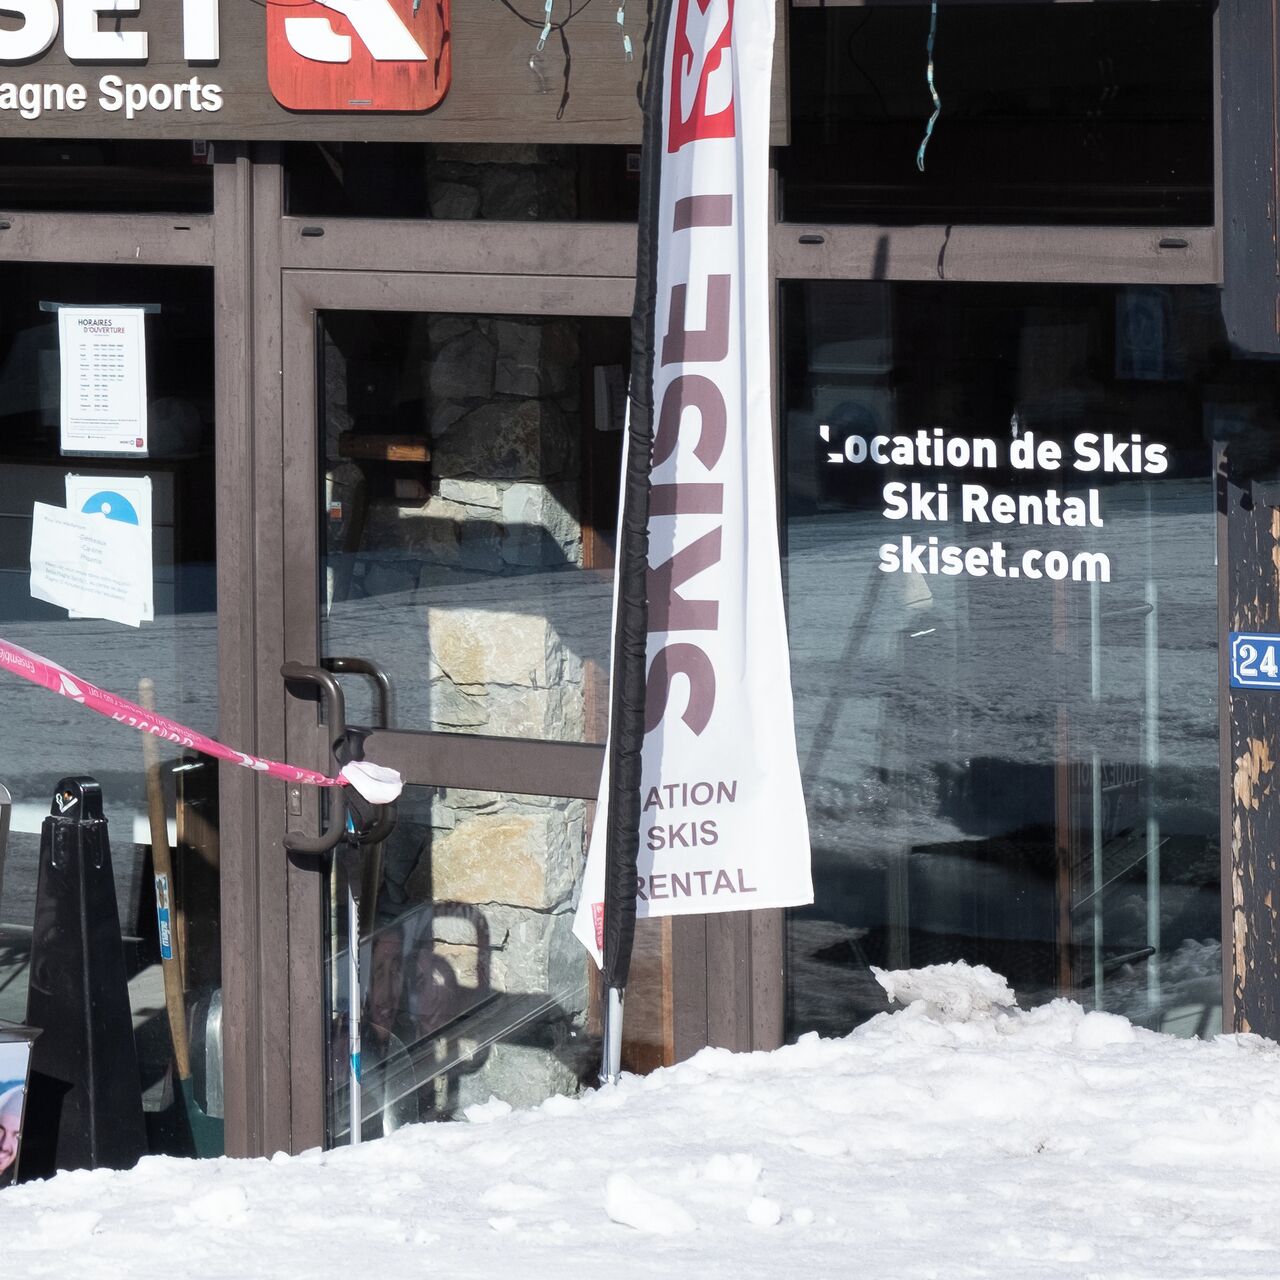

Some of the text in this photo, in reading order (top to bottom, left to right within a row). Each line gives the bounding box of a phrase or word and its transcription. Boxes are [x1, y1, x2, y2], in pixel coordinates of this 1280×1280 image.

[98, 75, 224, 118] Sports
[78, 319, 112, 327] HORAIRES
[1010, 431, 1061, 471] de
[1073, 432, 1168, 474] Skis
[881, 481, 1104, 528] Ski Rental
[878, 535, 1111, 583] skiset.com
[1238, 644, 1279, 679] 24
[646, 820, 719, 851] SKIS
[636, 868, 757, 901] RENTAL
